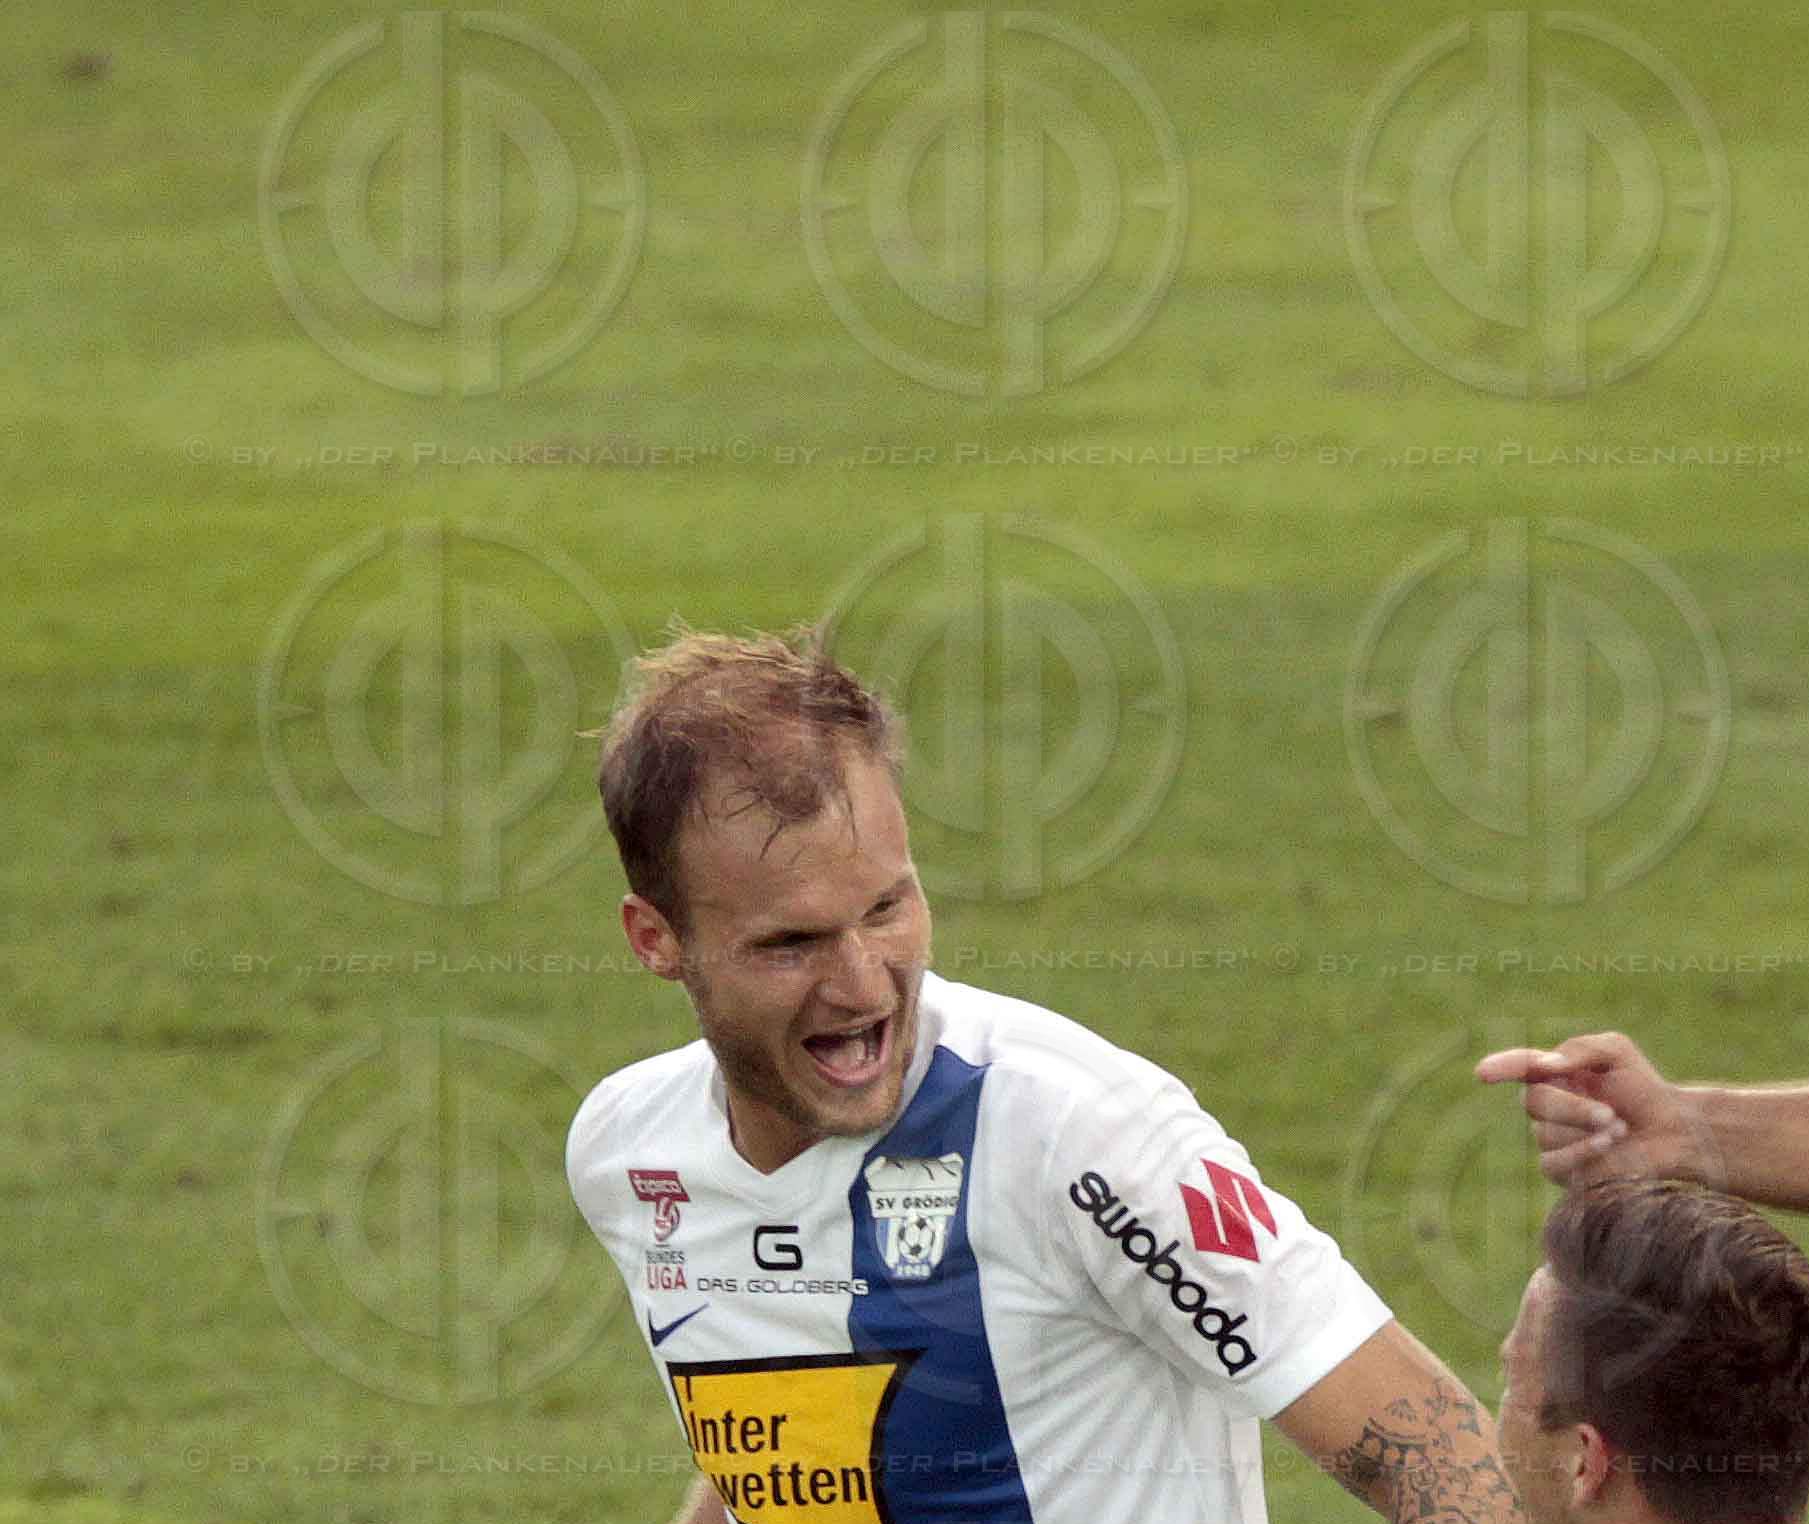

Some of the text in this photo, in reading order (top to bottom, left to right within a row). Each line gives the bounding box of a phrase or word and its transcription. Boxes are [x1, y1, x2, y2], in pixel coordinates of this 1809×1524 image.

[875, 1196, 896, 1211] SV
[753, 1225, 804, 1271] G
[1069, 1170, 1257, 1377] swoboda
